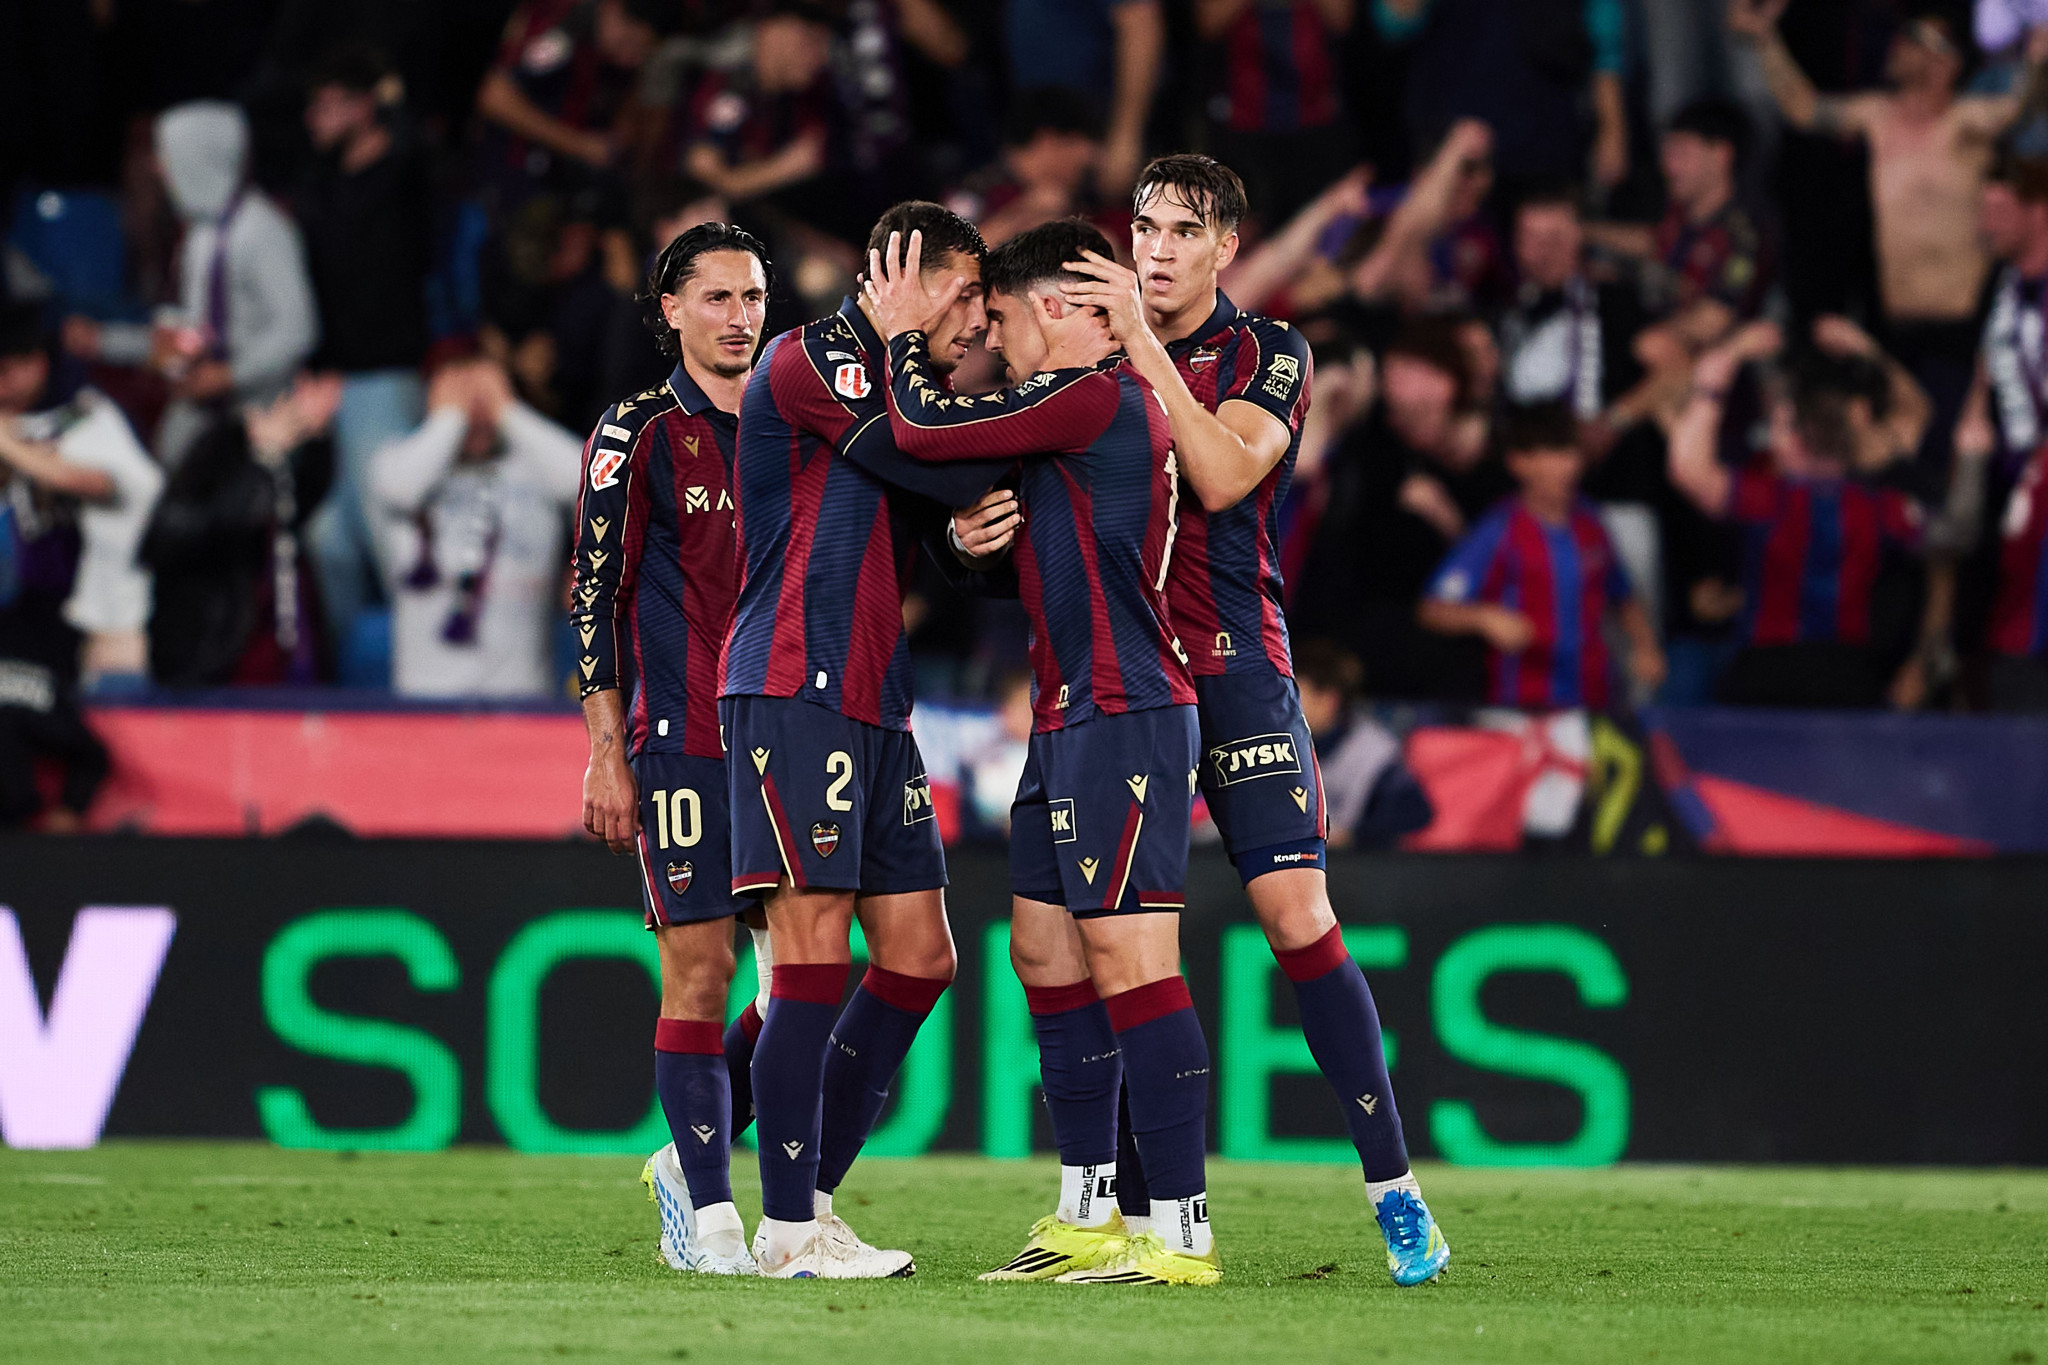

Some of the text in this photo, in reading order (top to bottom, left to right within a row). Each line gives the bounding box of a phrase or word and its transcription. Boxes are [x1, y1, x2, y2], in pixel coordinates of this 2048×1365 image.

[1261, 383, 1288, 401] HOME
[1229, 742, 1295, 772] JYSK
[826, 750, 853, 812] 2
[651, 788, 703, 850] 10
